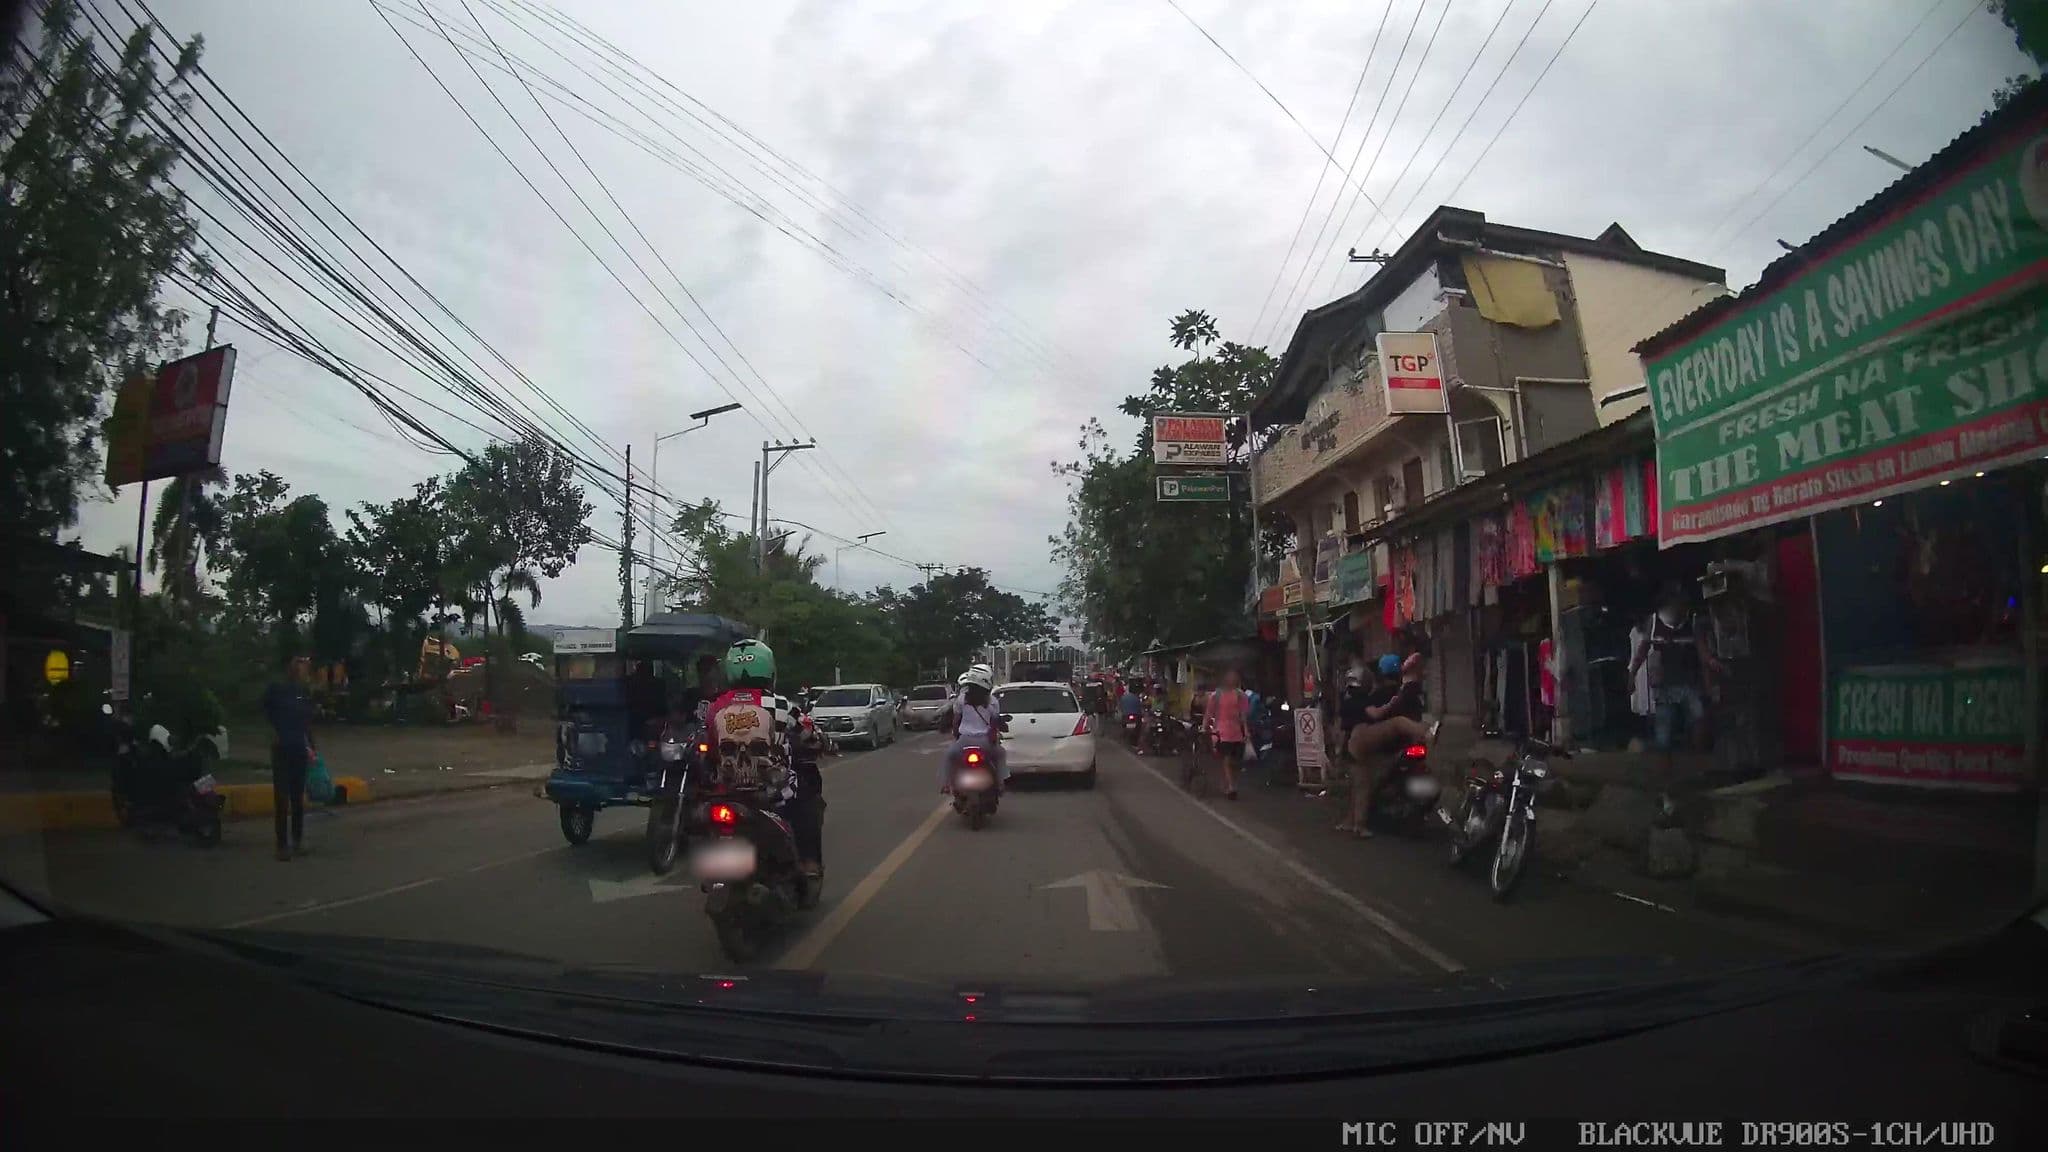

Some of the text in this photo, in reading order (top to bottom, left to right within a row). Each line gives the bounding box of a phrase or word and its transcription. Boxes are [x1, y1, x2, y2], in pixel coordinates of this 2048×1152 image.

[1658, 178, 2020, 421] EVERYDAY IS A SAVINGS DAY
[1389, 355, 1429, 371] TGP
[1718, 383, 1820, 445] FRESH
[1835, 357, 1887, 401] NA
[1669, 443, 1760, 501] THE
[1775, 385, 1923, 472] MEAT
[1838, 678, 2024, 738] FRESH NA FRESH
